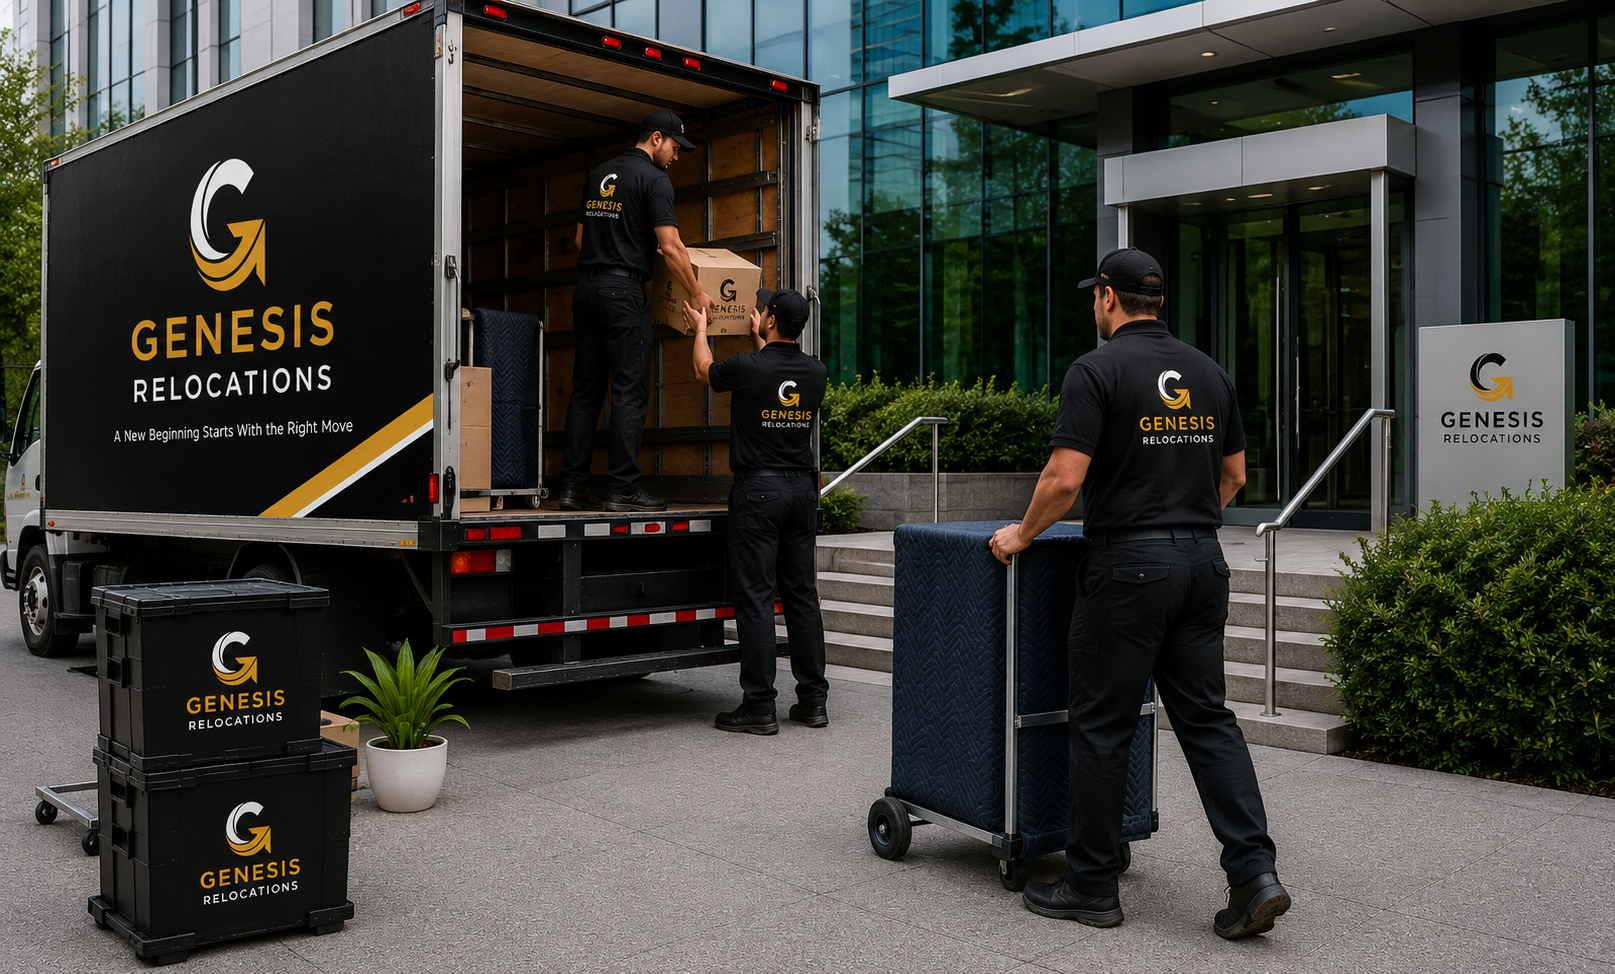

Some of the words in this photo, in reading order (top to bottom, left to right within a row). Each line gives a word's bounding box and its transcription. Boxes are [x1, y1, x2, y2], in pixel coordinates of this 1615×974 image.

[586, 200, 623, 211] GENESIS
[131, 300, 335, 362] GENESIS
[133, 364, 332, 403] RELOCATIONS
[761, 409, 812, 421] GENESIS
[1139, 415, 1215, 432] GENESIS
[1440, 410, 1544, 429] GENESIS
[113, 430, 122, 443] A
[124, 429, 146, 442] New
[149, 426, 200, 444] Beginning
[202, 425, 234, 439] Starts
[236, 422, 263, 437] With
[265, 422, 284, 436] the
[287, 420, 319, 438] Right
[321, 419, 354, 433] Move
[1142, 434, 1214, 445] RELOCATIONS
[1443, 433, 1541, 444] RELOCATIONS
[186, 689, 286, 715] GENESIS
[188, 711, 283, 731] RELOCATIONS
[200, 858, 301, 889] GENESIS
[203, 880, 299, 906] RELOCATIONS
